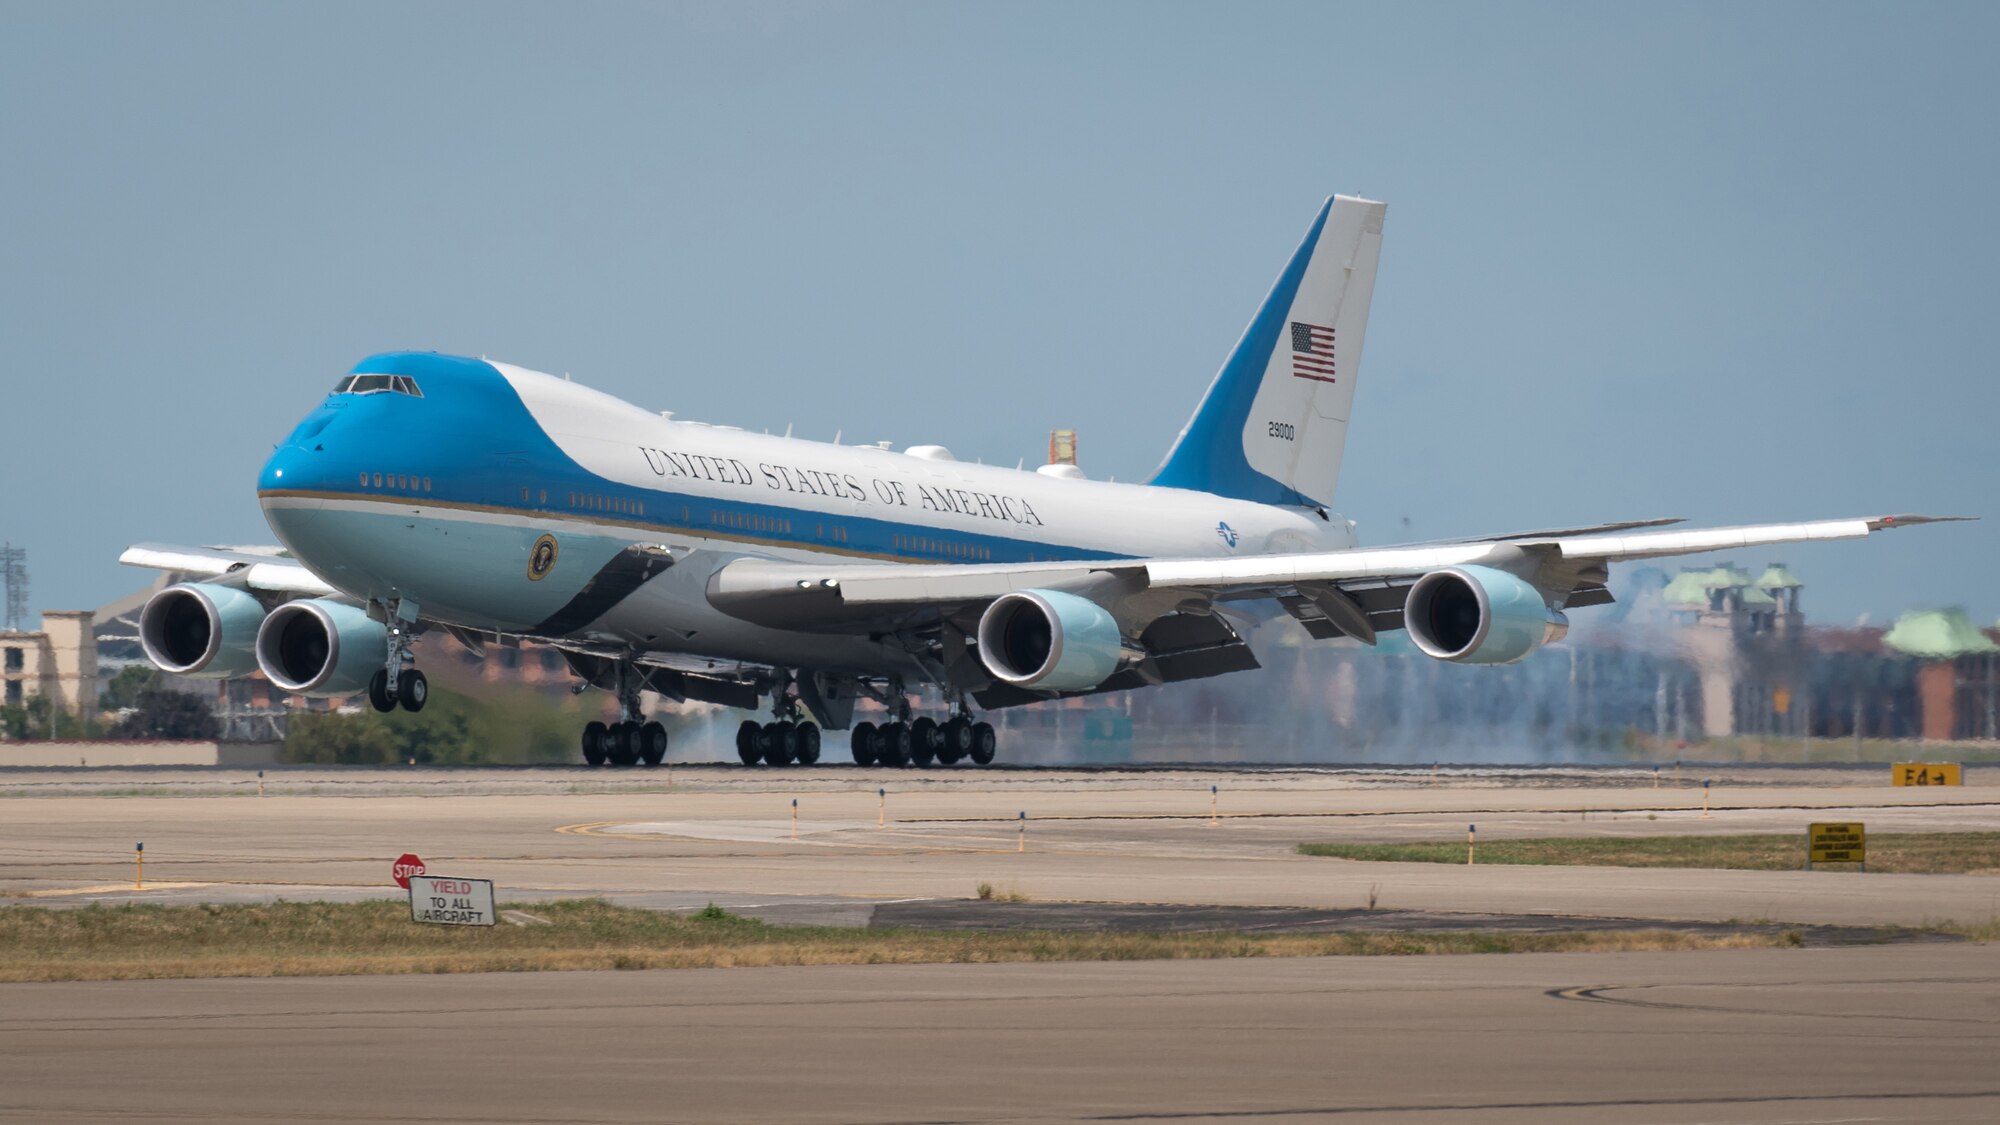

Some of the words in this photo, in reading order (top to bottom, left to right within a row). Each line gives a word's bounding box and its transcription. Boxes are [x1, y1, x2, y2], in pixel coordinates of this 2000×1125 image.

[1268, 421, 1295, 441] 29000
[638, 446, 754, 486] UNITED
[759, 462, 867, 502] STATES
[873, 478, 908, 506] OF
[918, 483, 1045, 526] AMERICA
[394, 864, 425, 878] STOP
[430, 880, 472, 895] YIELD
[430, 897, 446, 909] TO
[452, 898, 474, 910] ALL
[423, 909, 483, 923] AIRCRAFT
